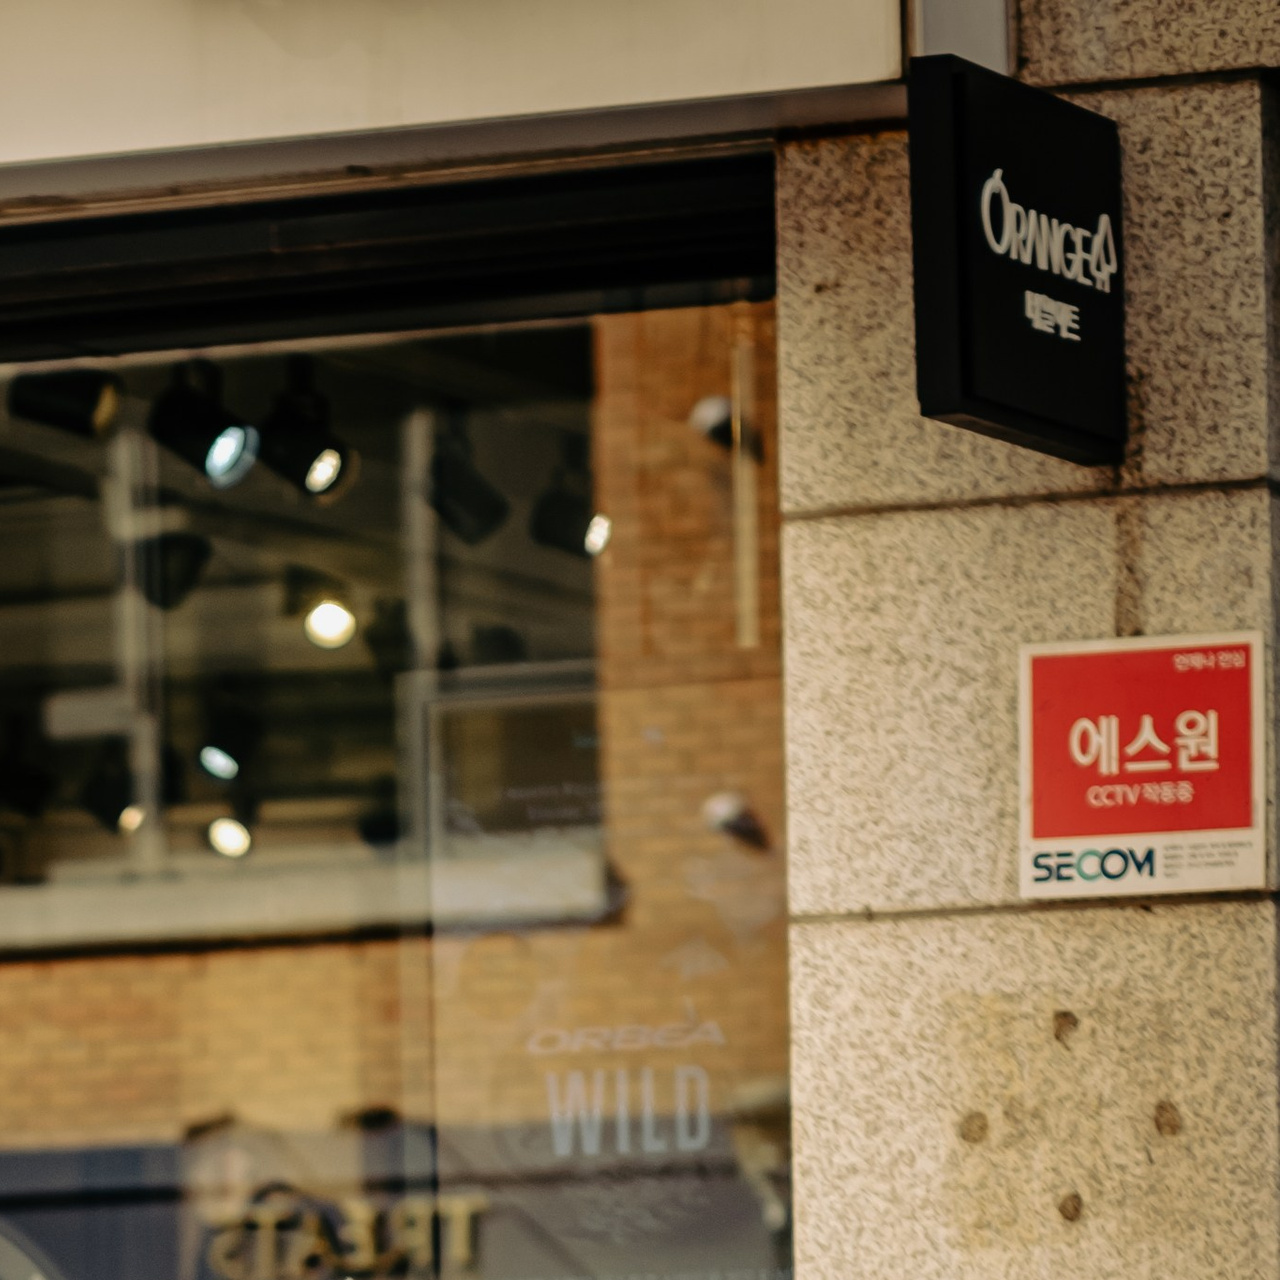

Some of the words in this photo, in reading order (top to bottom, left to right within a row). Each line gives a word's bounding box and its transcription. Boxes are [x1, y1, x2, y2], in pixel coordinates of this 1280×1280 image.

[1071, 709, 1219, 776] 에스원
[1086, 783, 1141, 807] CCTV
[1033, 848, 1156, 882] SECOM
[545, 1064, 712, 1157] WILD
